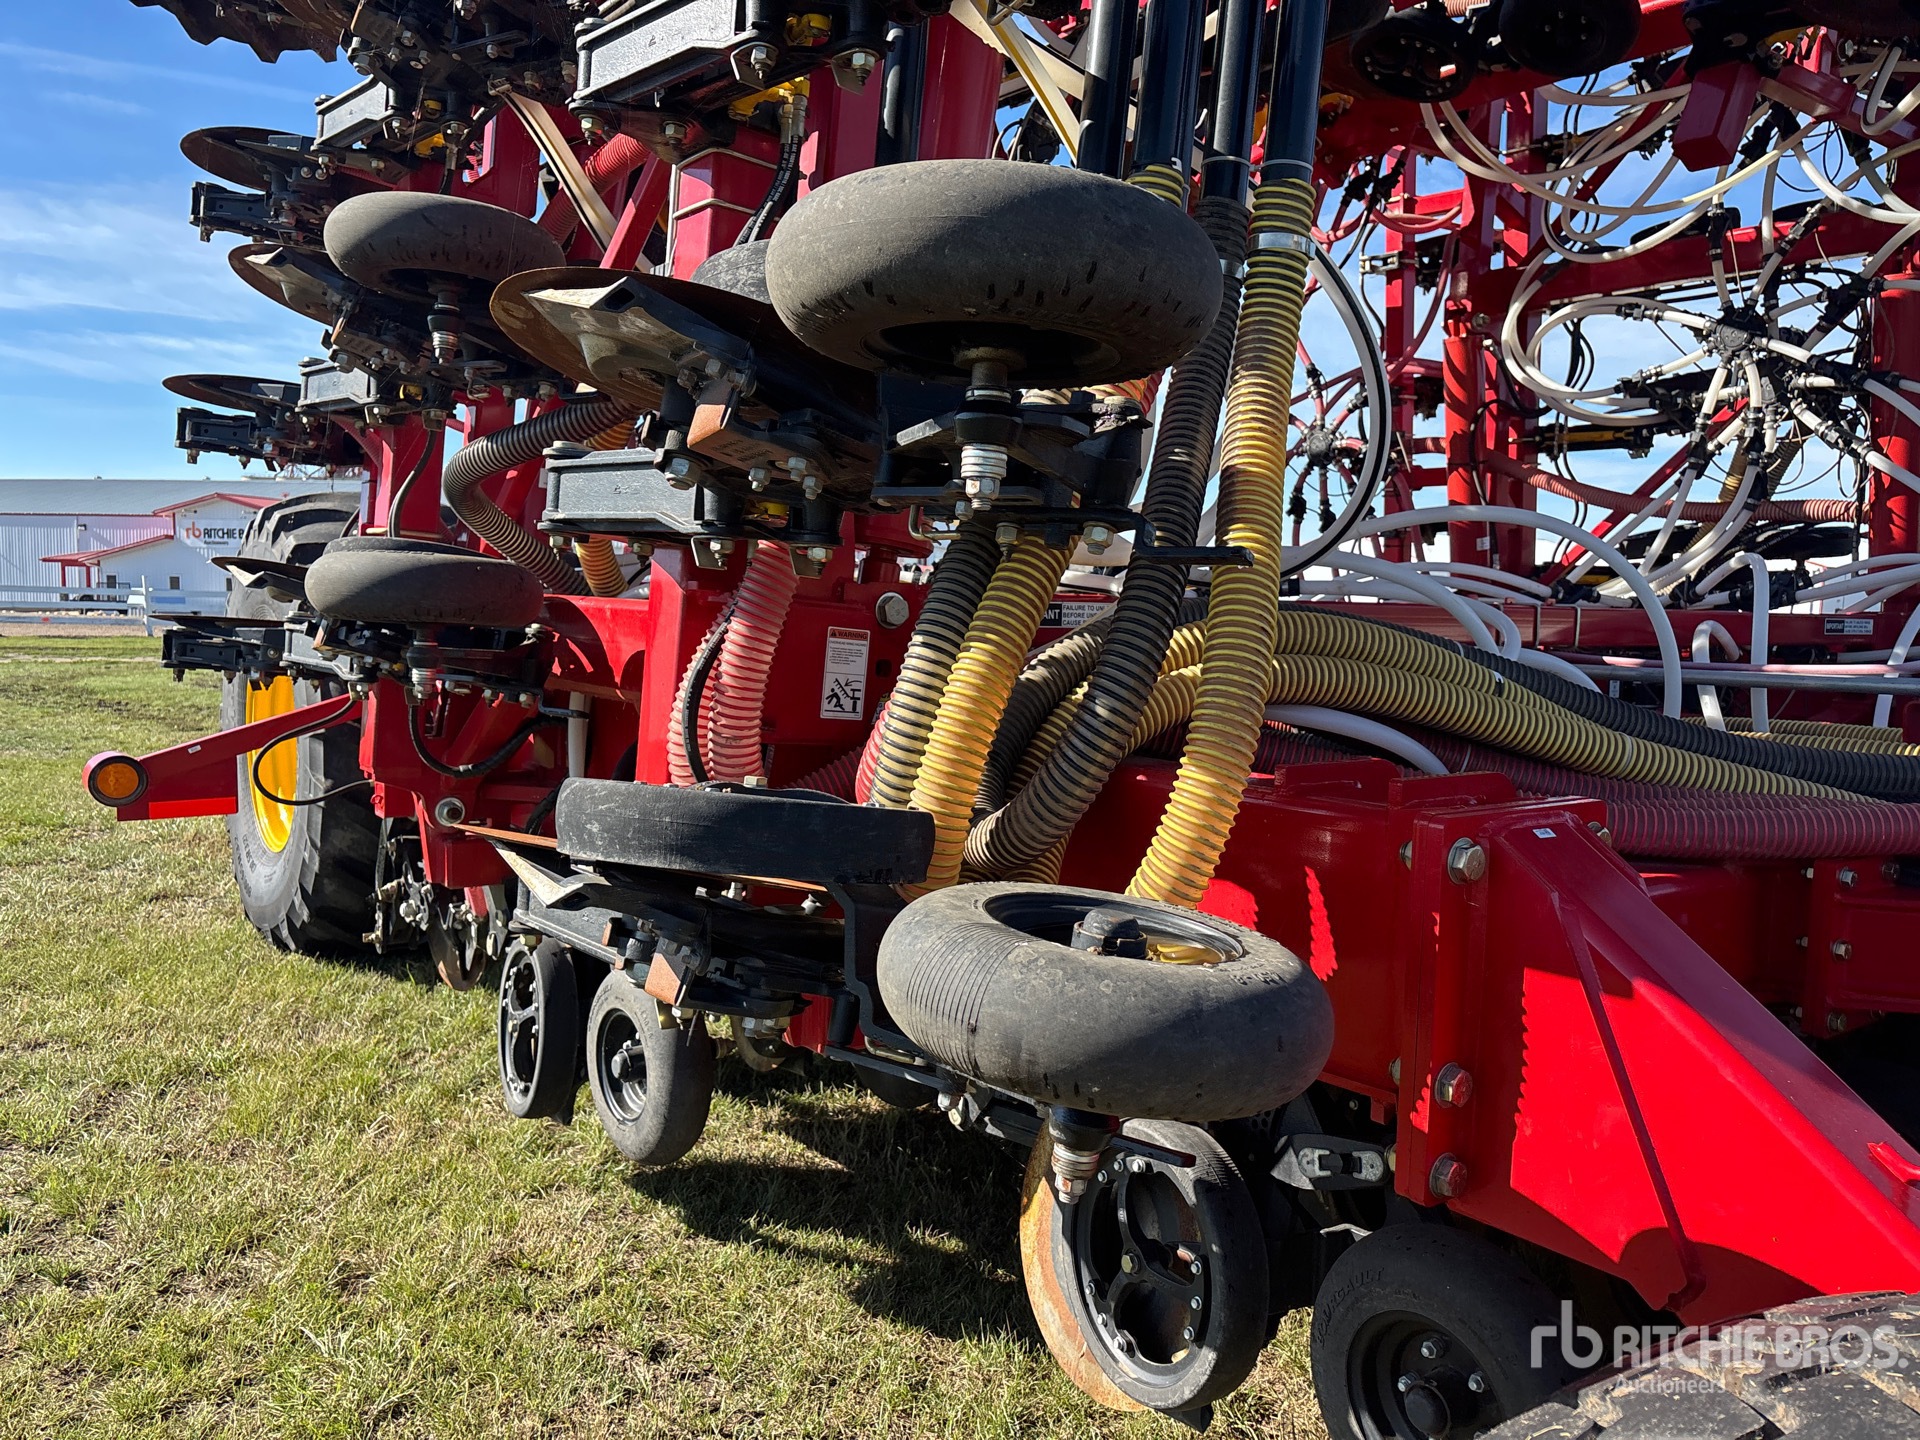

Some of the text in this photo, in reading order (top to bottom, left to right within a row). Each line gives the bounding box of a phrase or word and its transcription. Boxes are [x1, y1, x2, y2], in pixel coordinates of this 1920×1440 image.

[185, 521, 202, 539] rb
[203, 528, 237, 539] RITCHIE
[838, 631, 867, 639] WARNING
